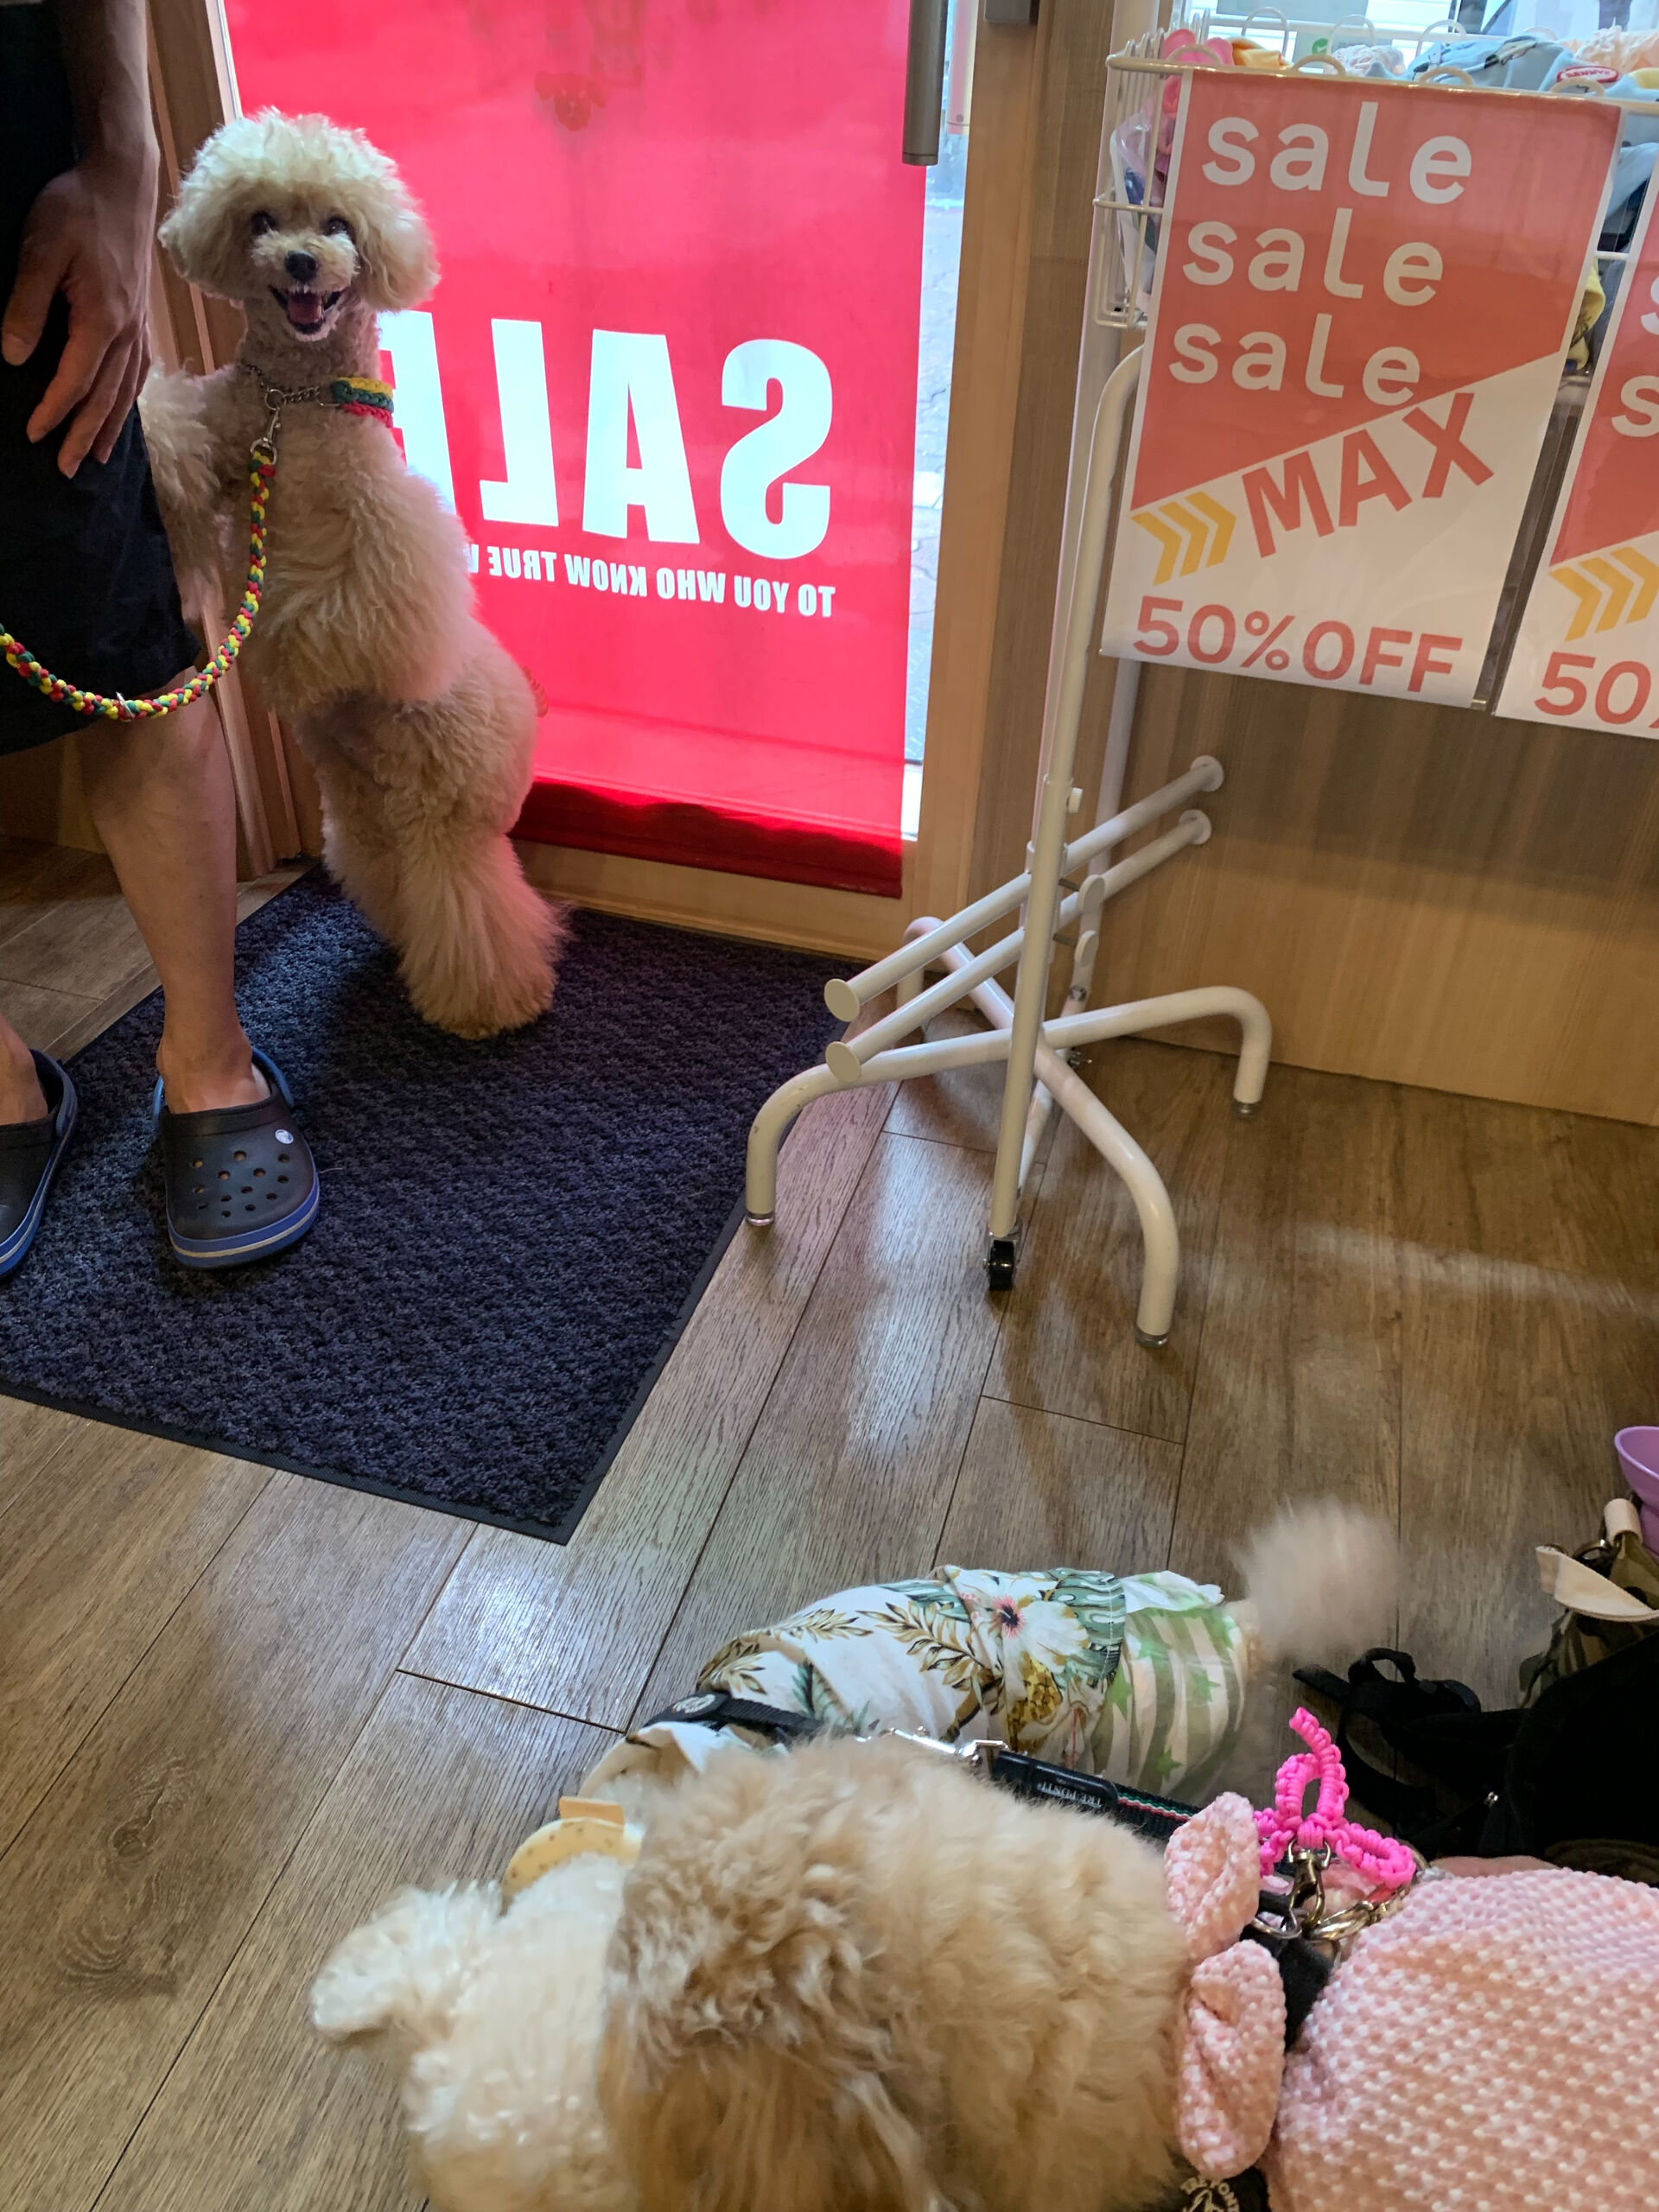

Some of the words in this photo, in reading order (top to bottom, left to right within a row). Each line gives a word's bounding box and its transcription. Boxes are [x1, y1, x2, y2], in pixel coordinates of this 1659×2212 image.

[1202, 101, 1472, 205] sale
[1182, 207, 1444, 307] sale
[1168, 313, 1421, 406] sale
[1241, 391, 1494, 558] MAX
[1133, 595, 1463, 693] 50%OFF
